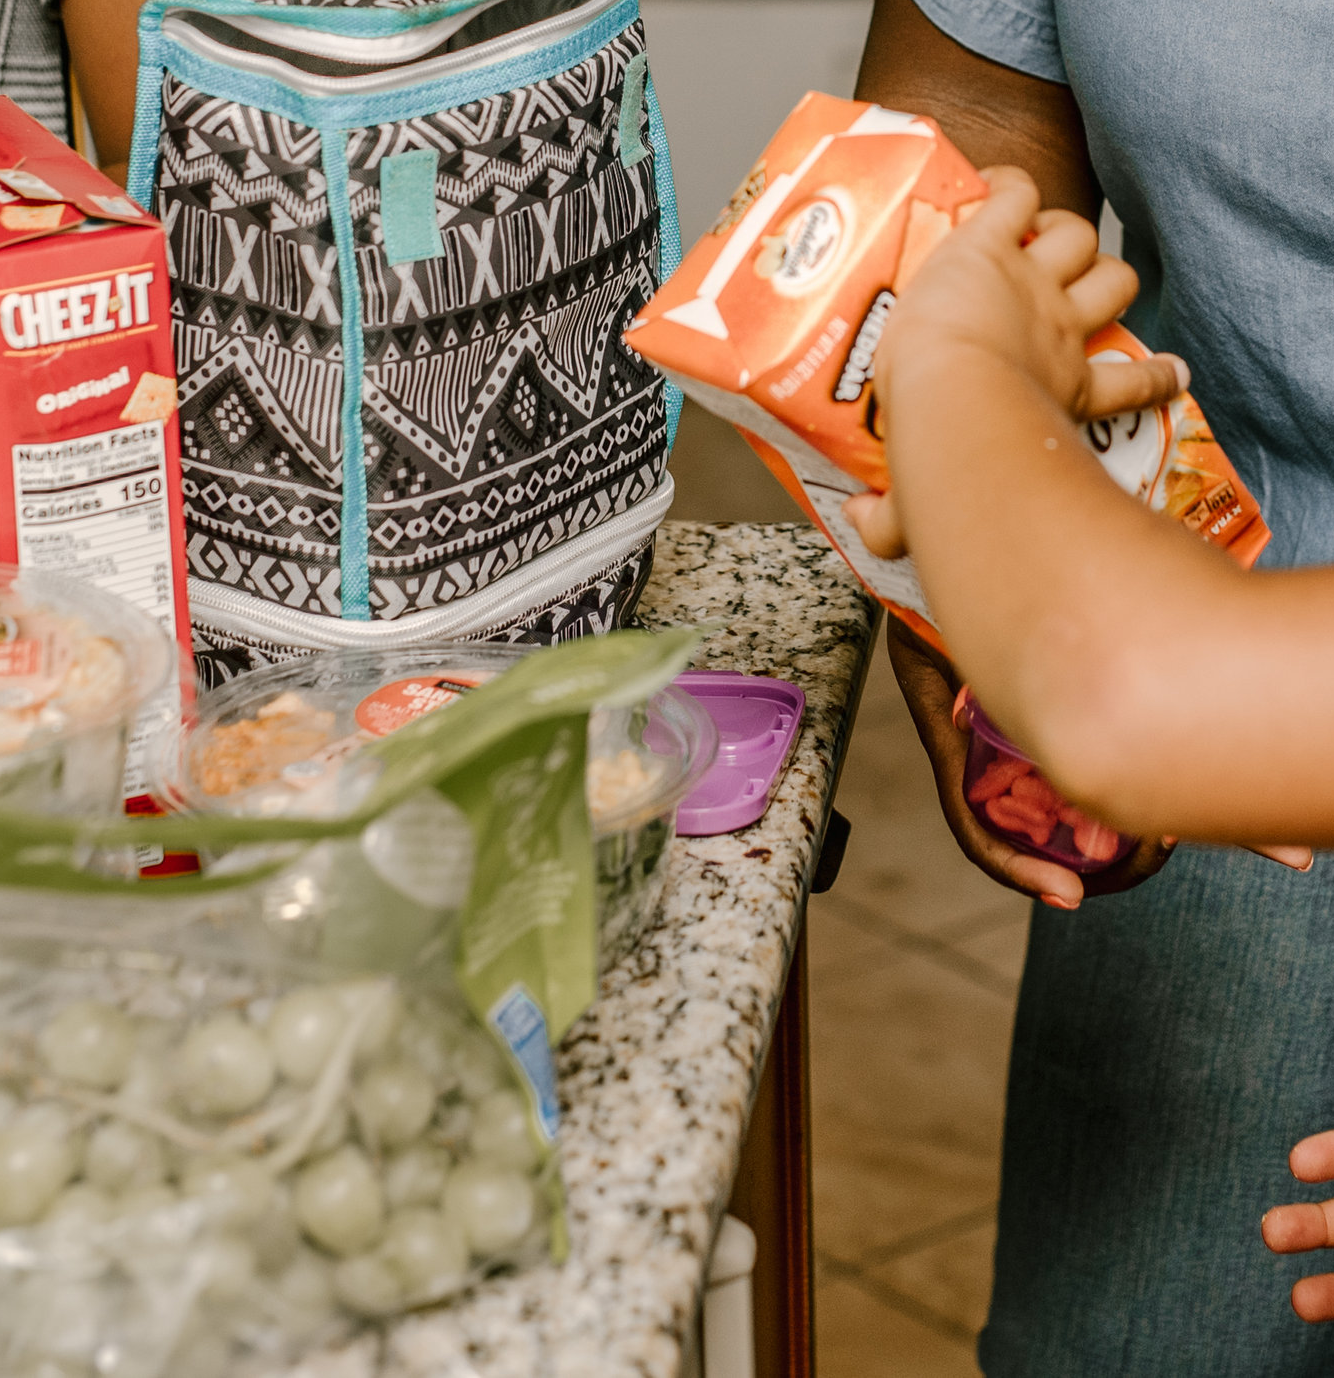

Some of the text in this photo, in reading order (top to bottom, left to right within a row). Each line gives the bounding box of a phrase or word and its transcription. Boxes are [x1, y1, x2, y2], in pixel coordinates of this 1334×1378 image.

[835, 290, 897, 401] CHEDDAR
[19, 428, 158, 462] Nutrition Facts
[22, 498, 103, 519] Calories
[120, 477, 162, 502] 150
